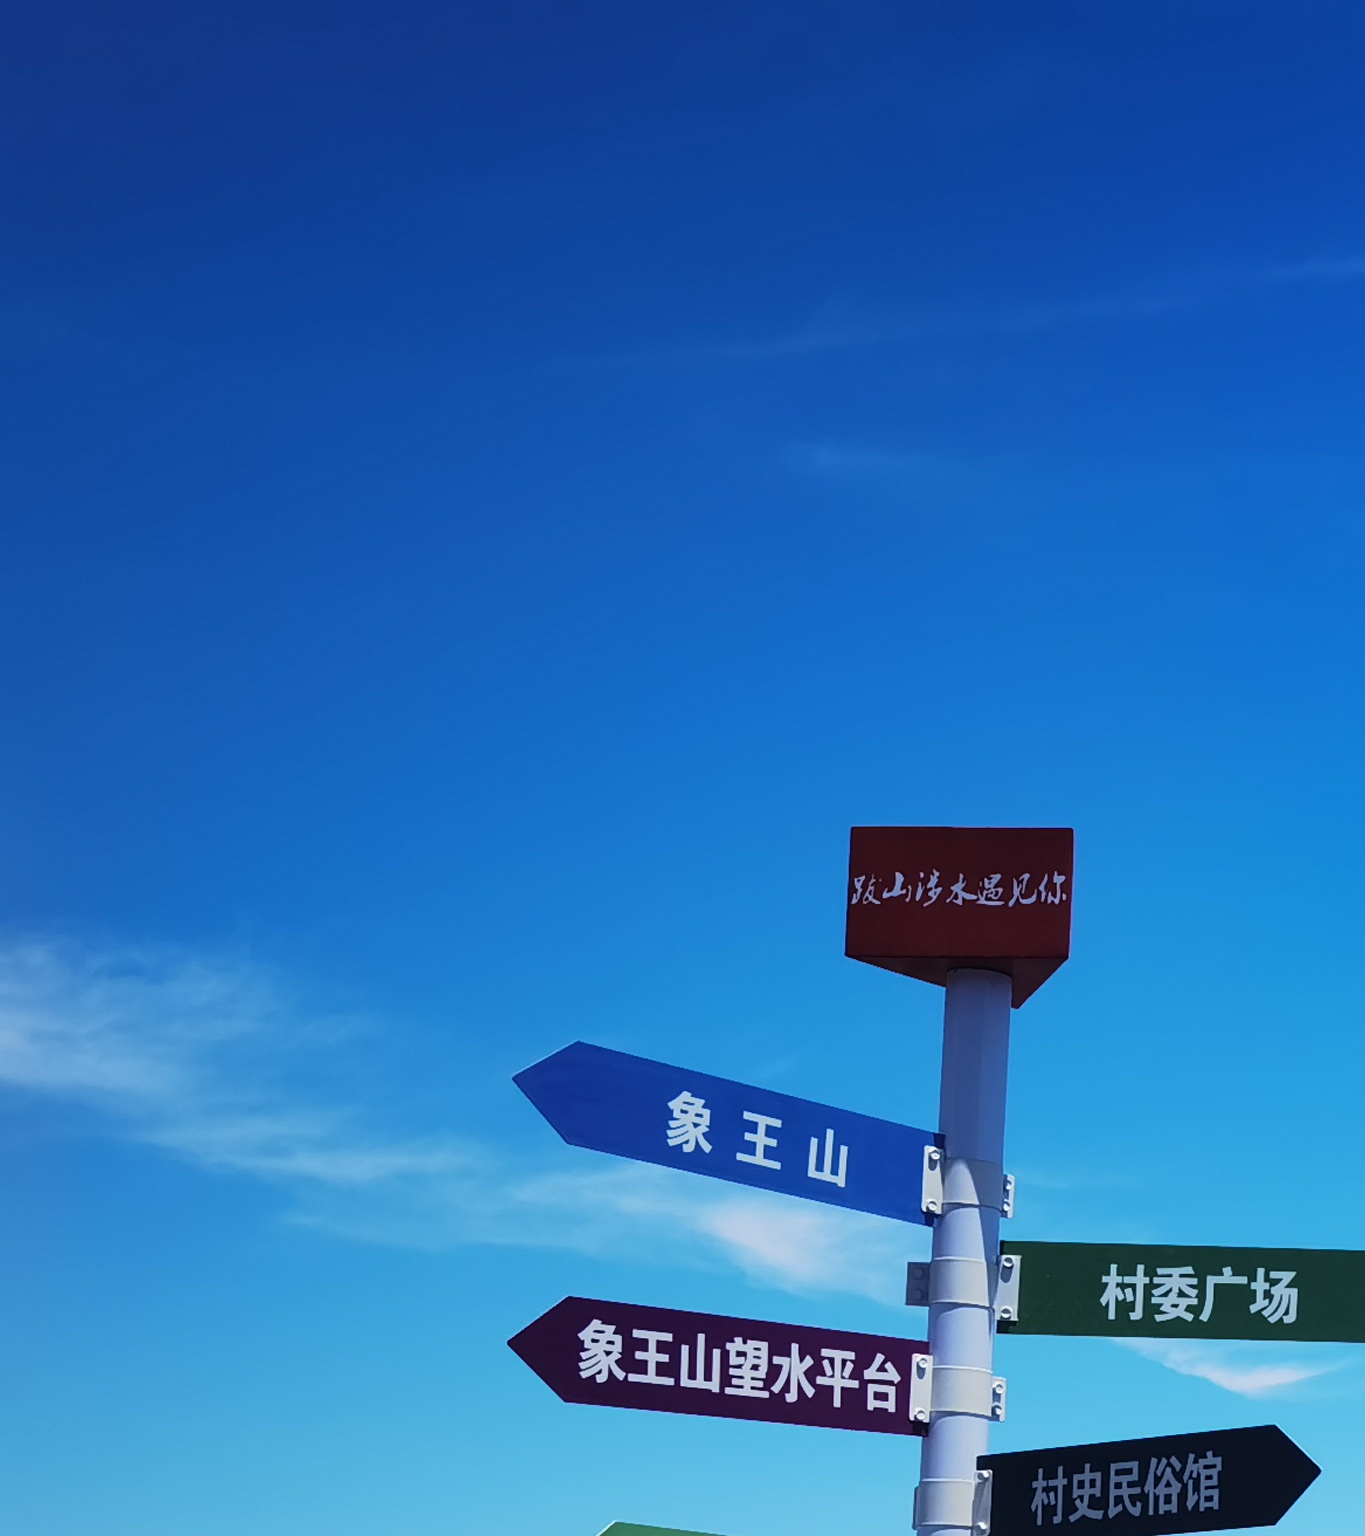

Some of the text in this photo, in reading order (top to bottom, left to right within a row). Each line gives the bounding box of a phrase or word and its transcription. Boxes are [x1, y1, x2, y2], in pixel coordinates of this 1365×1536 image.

[851, 868, 1067, 908] 跋山涉水遇见你
[665, 1090, 849, 1189] 象王山
[1099, 1263, 1299, 1326] 村委广场
[576, 1319, 901, 1414] 象王山望水平台
[1031, 1451, 1222, 1526] 村史民俗馆
